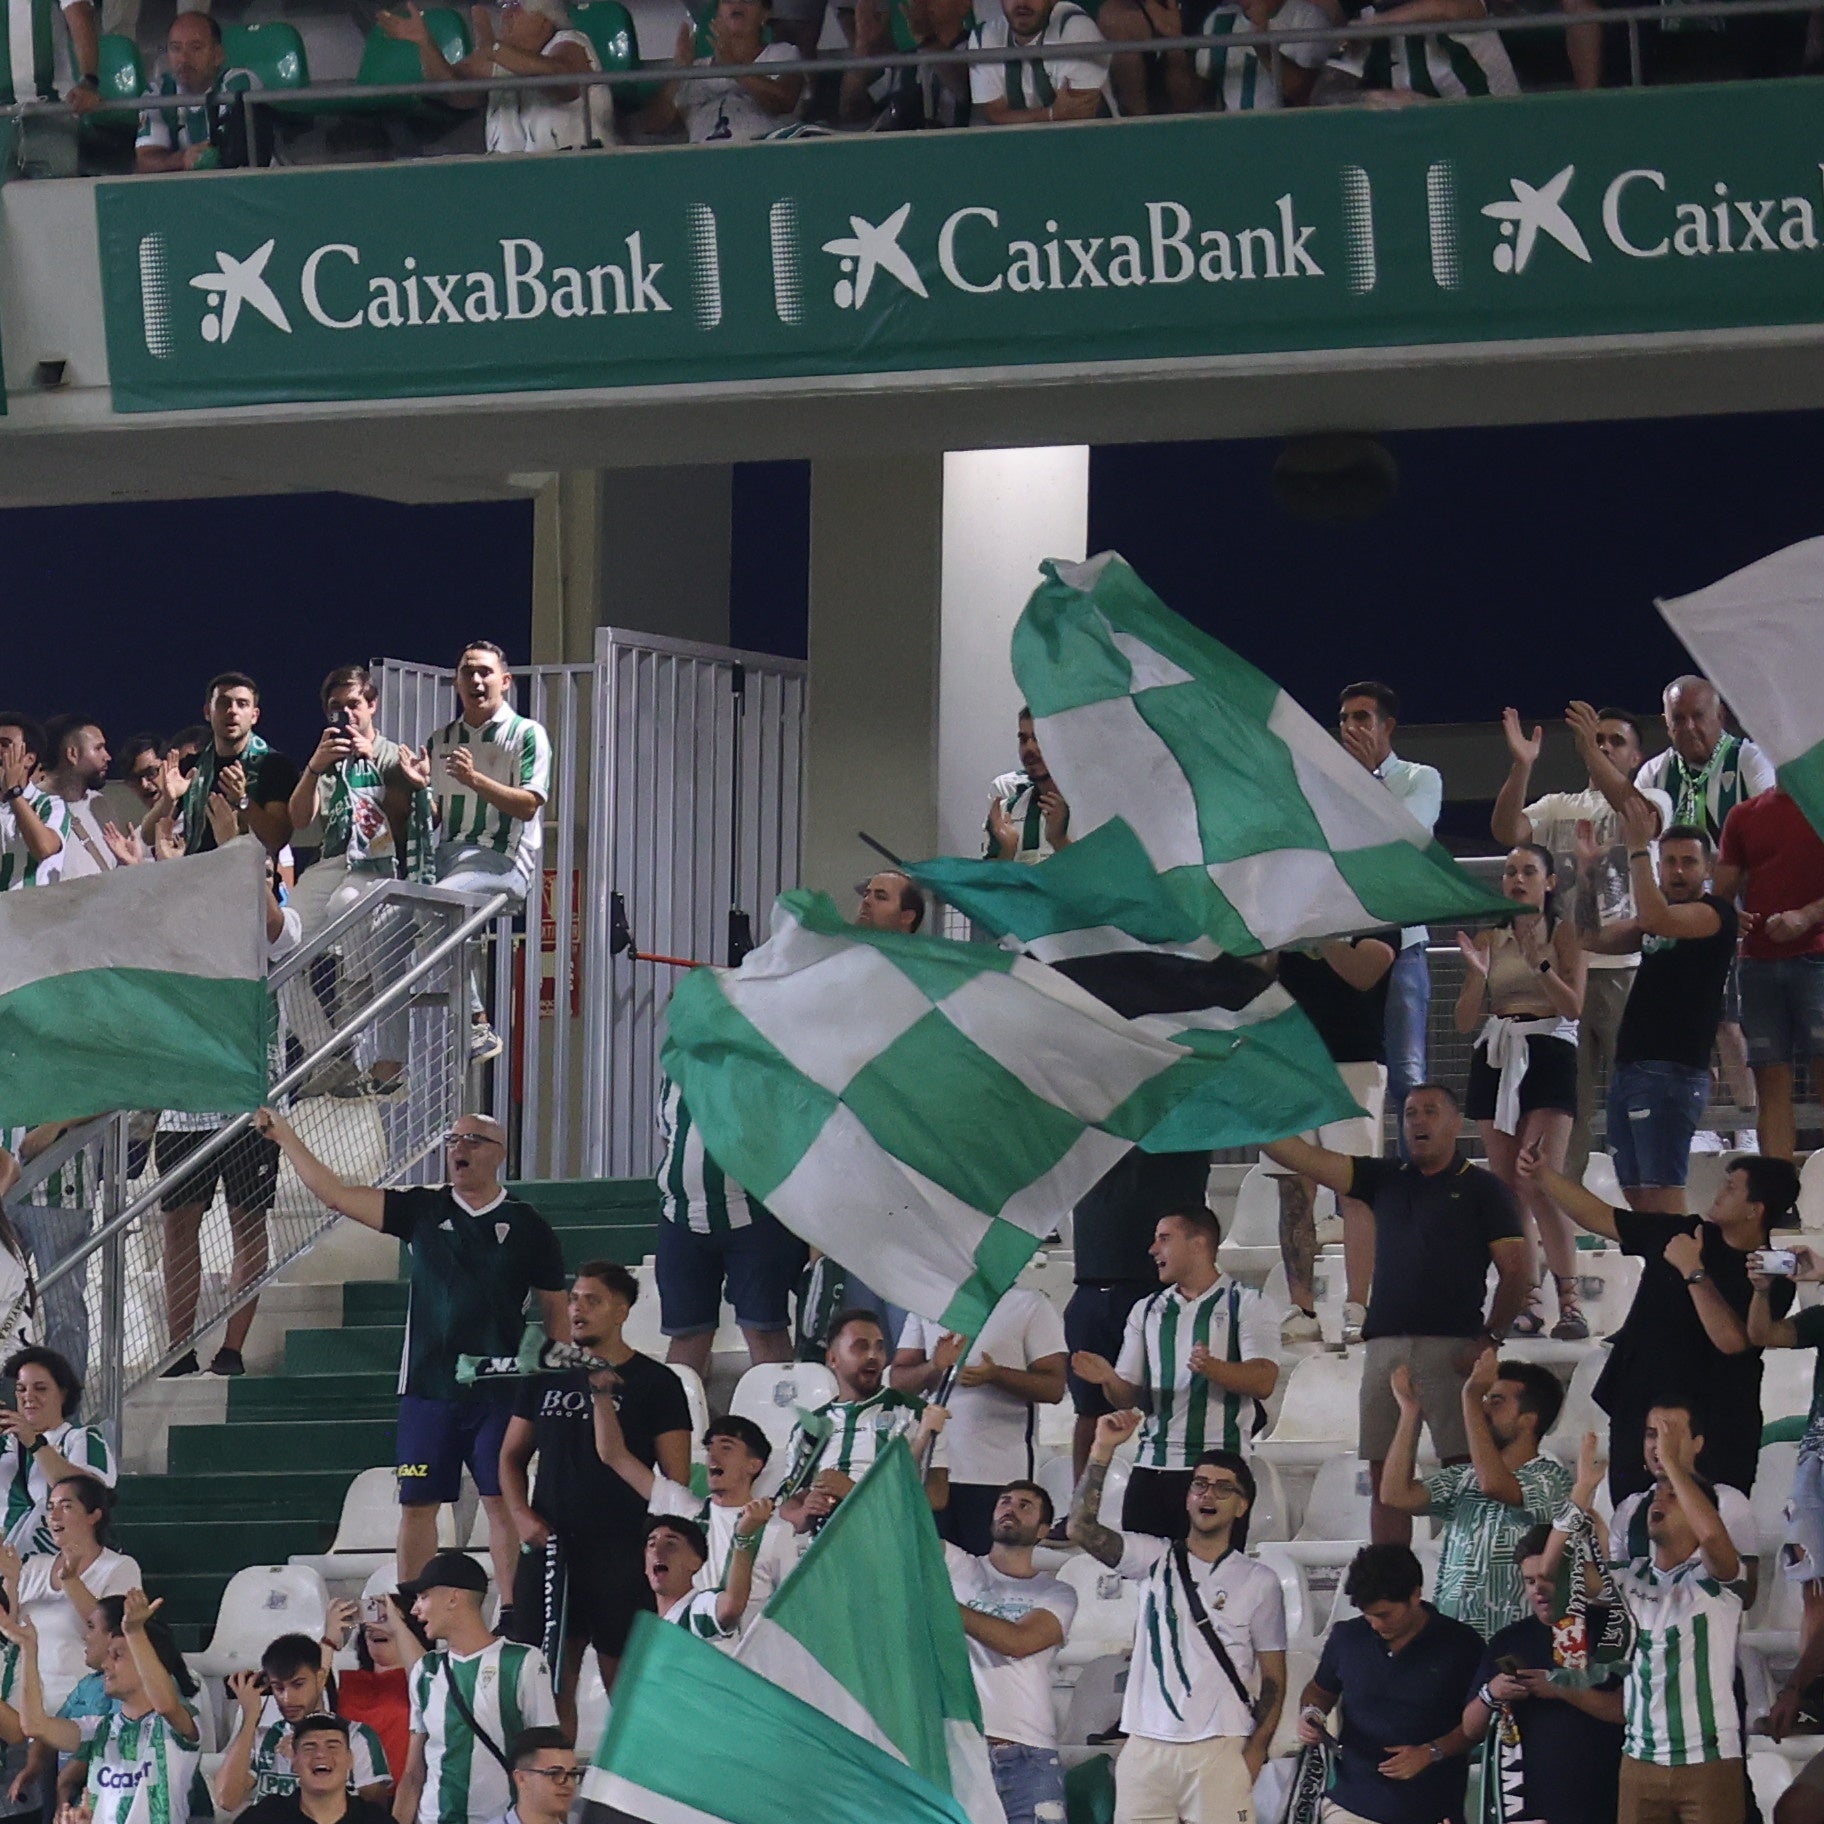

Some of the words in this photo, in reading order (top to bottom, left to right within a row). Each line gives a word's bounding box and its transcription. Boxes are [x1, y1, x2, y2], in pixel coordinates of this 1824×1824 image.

[938, 194, 1325, 294] CaixaBank
[1602, 163, 1824, 259] Caixa
[301, 230, 672, 331] CaixaBank
[542, 1388, 622, 1412] BOS
